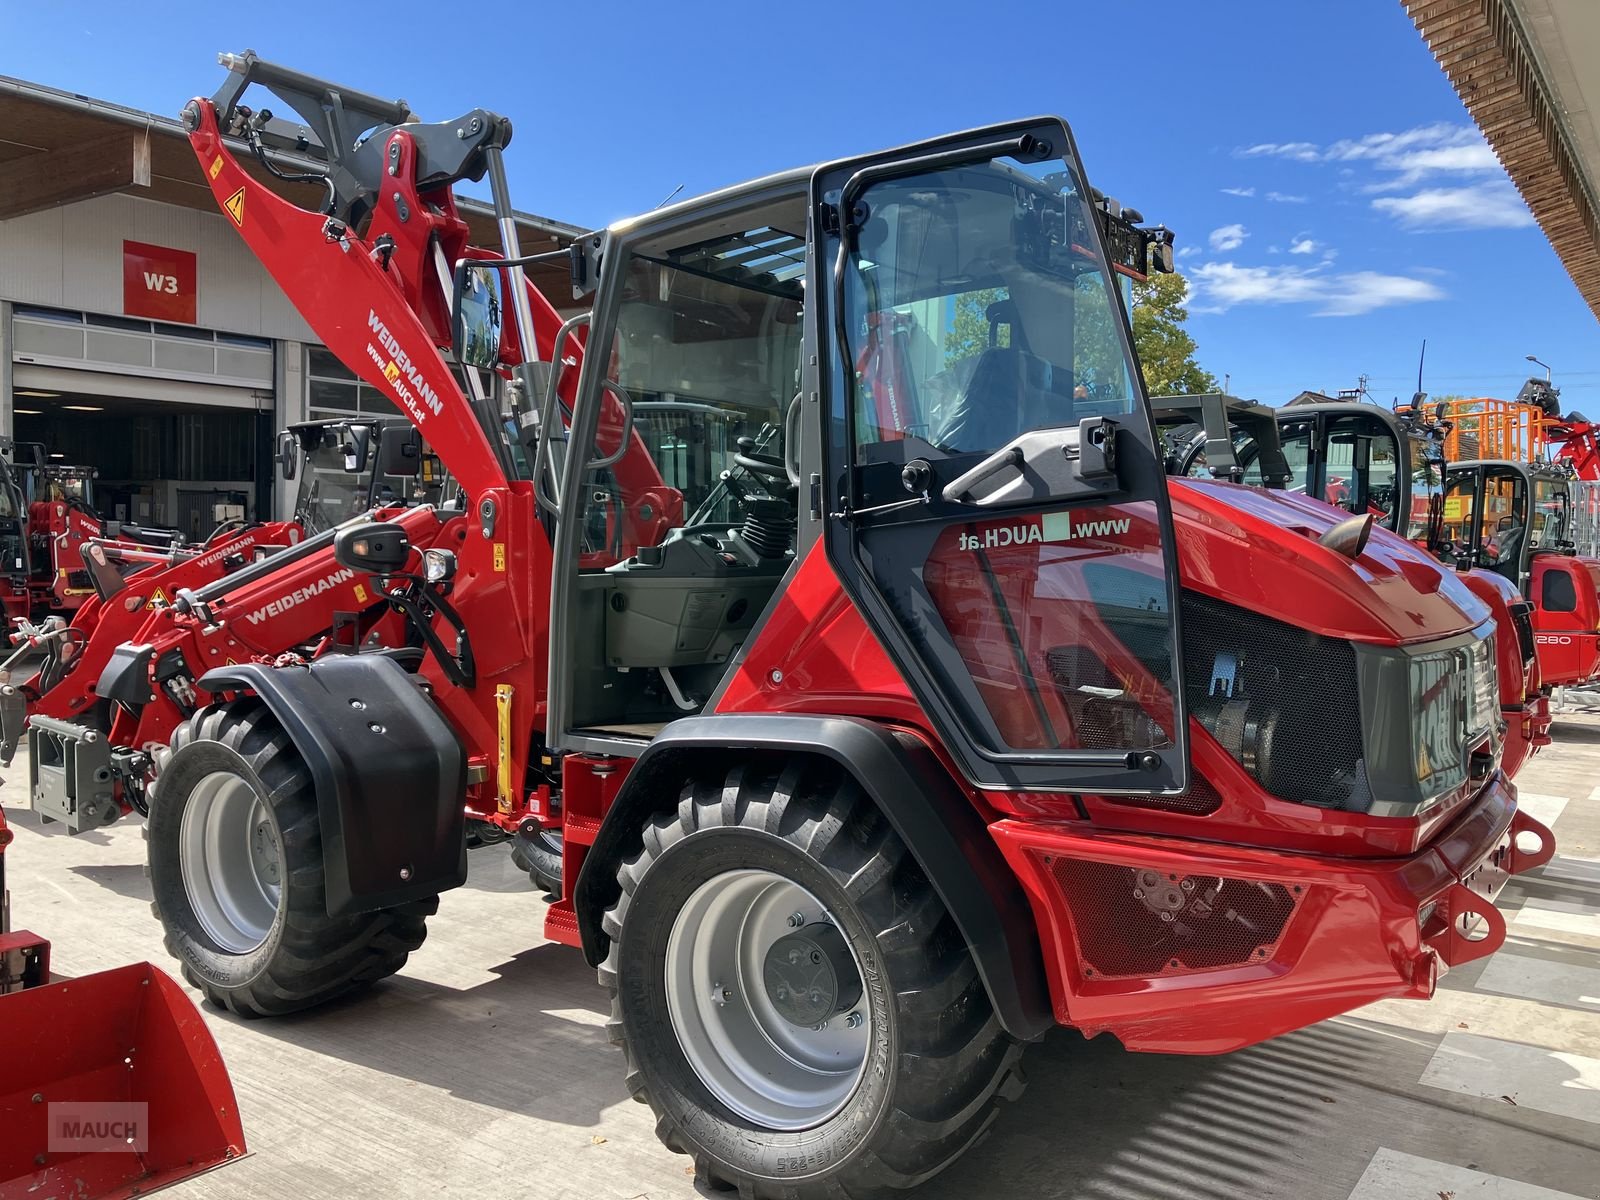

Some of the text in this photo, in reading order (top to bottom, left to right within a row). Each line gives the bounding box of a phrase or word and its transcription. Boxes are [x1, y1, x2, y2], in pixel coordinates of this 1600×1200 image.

[144, 271, 178, 294] W3
[366, 342, 427, 425] www.MAUCH.at
[367, 308, 444, 417] WEIDEMANN
[197, 535, 255, 568] WEIDEMANN
[245, 567, 354, 625] WEIDEMANN
[1535, 635, 1571, 645] 280
